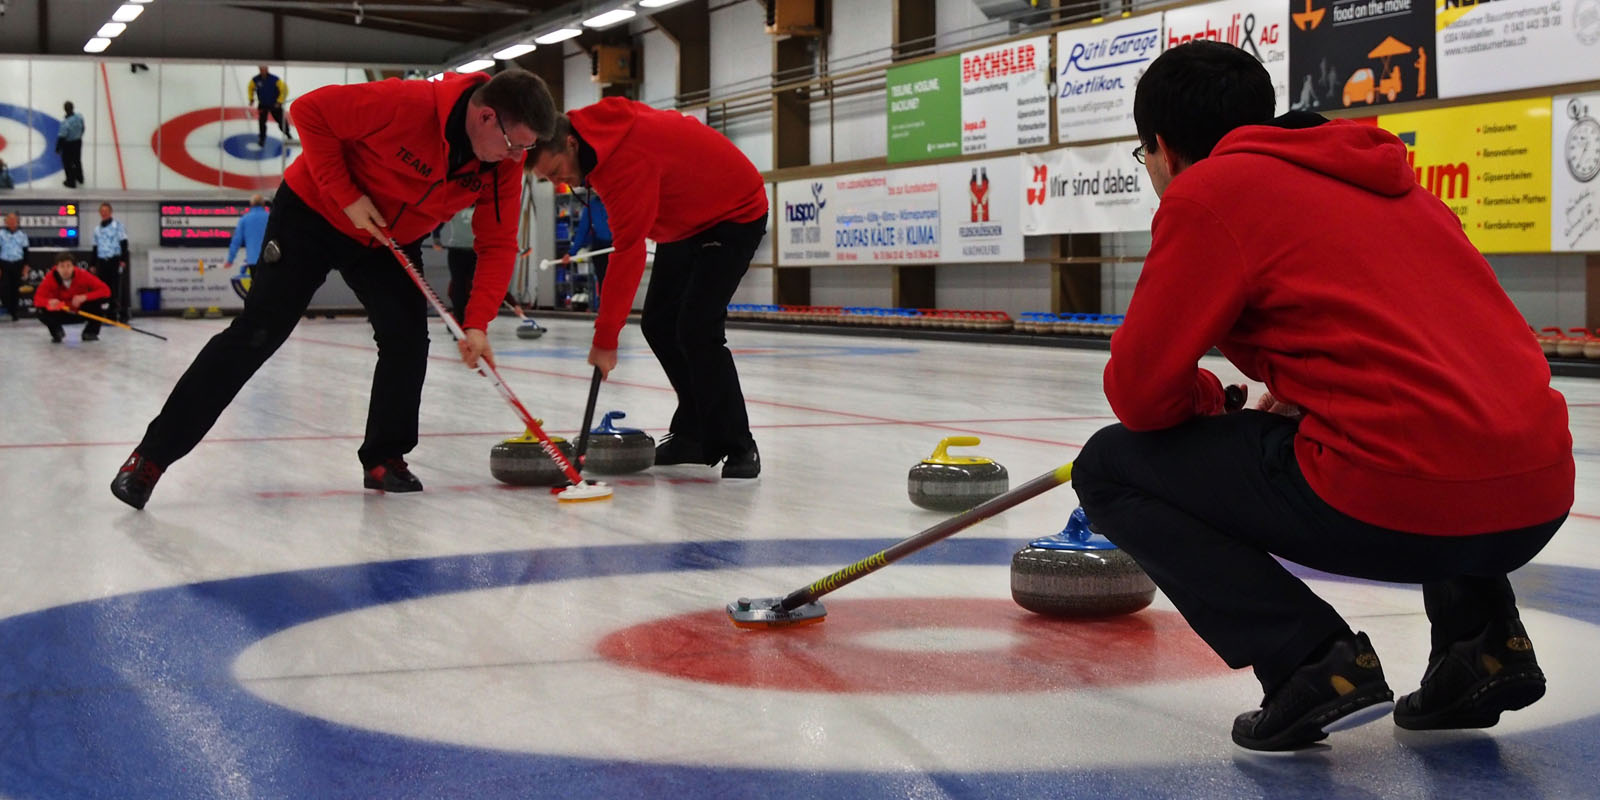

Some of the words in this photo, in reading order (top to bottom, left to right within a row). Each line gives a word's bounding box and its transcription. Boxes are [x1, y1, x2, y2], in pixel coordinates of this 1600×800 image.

[1333, 4, 1354, 22] food
[1355, 6, 1367, 17] on
[1368, 0, 1383, 15] the
[1259, 23, 1279, 46] AG
[963, 44, 1036, 83] BOCHSLER
[1061, 38, 1108, 76] Rütli
[1109, 28, 1158, 57] Garage
[1060, 75, 1125, 98] Dietlikon
[1482, 123, 1517, 134] Umbauten
[396, 146, 433, 178] TEAM
[1482, 146, 1528, 158] Renovationen
[1050, 174, 1068, 197] Wir
[1072, 167, 1099, 196] sind
[1103, 166, 1140, 194] dabei.
[1483, 170, 1532, 183] Gipserarbeiten
[1483, 194, 1520, 206] Keramische
[1522, 193, 1546, 204] Platten
[785, 201, 815, 226] huspo
[836, 228, 868, 248] DOUFAS
[871, 223, 895, 247] KÄLTE
[905, 225, 935, 246] KLIMA
[540, 440, 569, 472] ASHAM
[809, 550, 888, 594] BalancePlus
